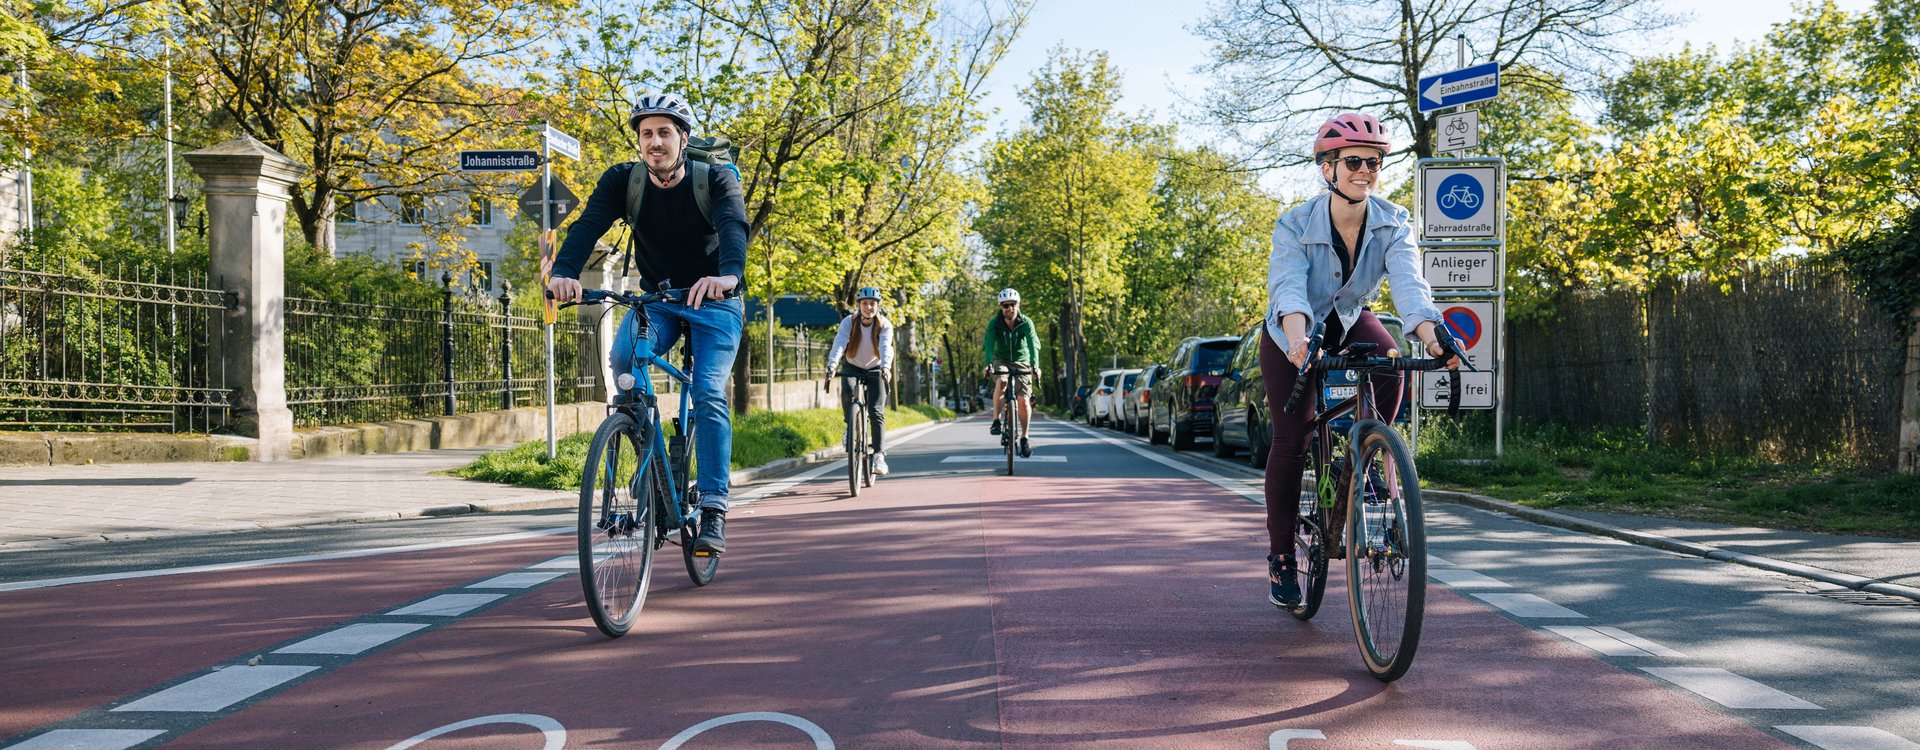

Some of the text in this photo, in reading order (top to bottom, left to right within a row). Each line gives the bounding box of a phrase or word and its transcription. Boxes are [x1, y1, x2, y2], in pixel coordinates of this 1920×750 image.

[1440, 77, 1494, 95] Einbahnstraße
[464, 155, 535, 167] Johannisstraße
[1428, 224, 1492, 232] Fahrradstraße
[1431, 257, 1487, 270] Anlieger
[1448, 271, 1471, 282] frei
[1465, 384, 1488, 395] frei
